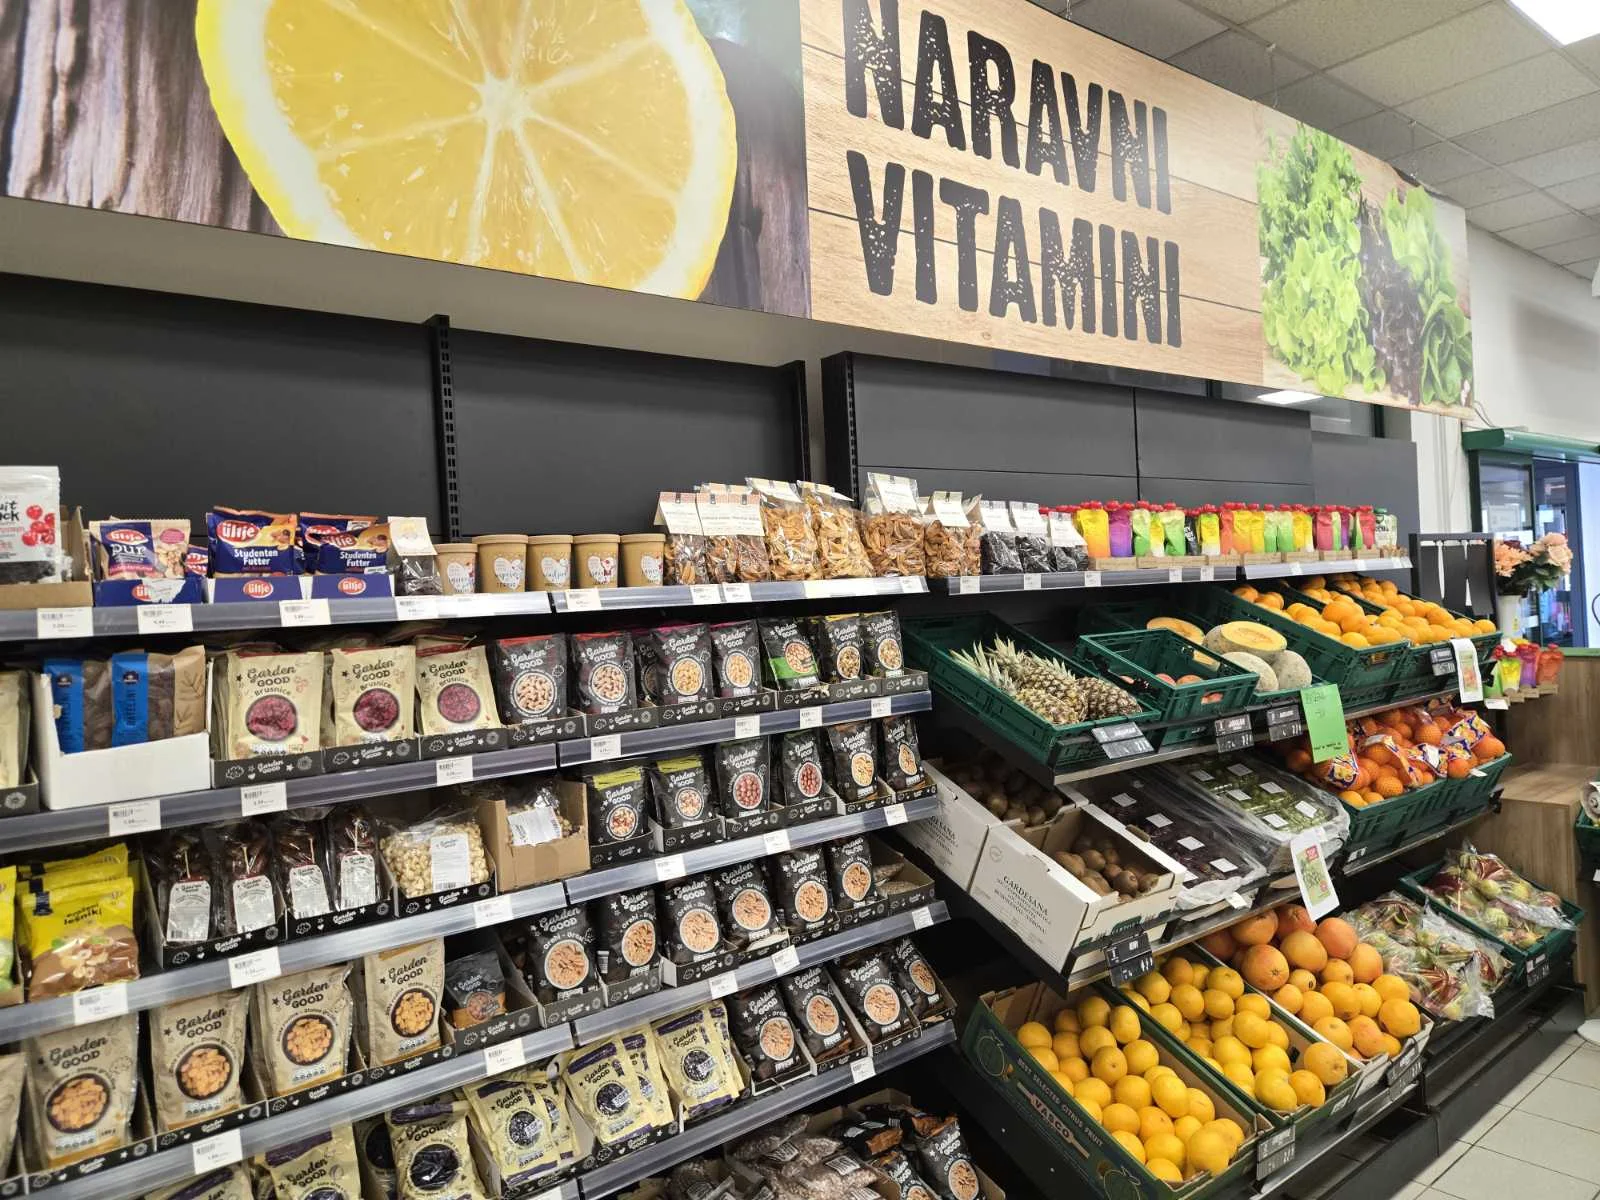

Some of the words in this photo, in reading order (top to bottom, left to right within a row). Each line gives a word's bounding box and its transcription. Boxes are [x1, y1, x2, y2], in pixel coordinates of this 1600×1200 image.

[842, 0, 1172, 215] NARAVNI
[846, 149, 1182, 348] VITAMINI
[221, 523, 255, 540] ültje
[110, 543, 146, 556] pur
[234, 549, 278, 558] Studenten
[340, 551, 376, 559] Studenten
[243, 558, 271, 566] Futter
[346, 559, 370, 567] Futter
[249, 583, 270, 594] ültje
[669, 634, 698, 651] Garden
[677, 643, 695, 653] GOOD
[510, 649, 546, 666] Garden
[586, 643, 618, 660] Garden
[595, 652, 616, 663] GOOD
[352, 658, 394, 679] Garden
[429, 659, 467, 676] Garden
[520, 658, 543, 669] GOOD
[247, 665, 296, 683] Garden
[257, 676, 290, 687] GOOD
[362, 670, 391, 682] GOOD
[439, 668, 465, 679] GOOD
[730, 749, 758, 764] Garden
[736, 758, 755, 768] GOOD
[670, 771, 695, 784] Garden
[678, 778, 695, 786] GOOD
[605, 786, 633, 800] Garden
[613, 794, 631, 804] GOOD
[790, 854, 820, 872] Garden
[798, 862, 818, 873] GOOD
[721, 863, 754, 884] Garden
[731, 871, 753, 885] GOOD
[674, 881, 707, 898] Garden
[683, 889, 705, 901] GOOD
[1003, 875, 1048, 916] GARDESANA
[539, 907, 581, 931] Garden
[550, 917, 577, 932] GOOD
[388, 956, 427, 982] Garden
[397, 968, 423, 985] GOOD
[850, 958, 879, 980] Garden
[860, 966, 880, 982] GOOD
[282, 981, 329, 1005] Garden
[292, 993, 324, 1008] GOOD
[749, 989, 776, 1012] Garden
[758, 999, 778, 1015] GOOD
[176, 1007, 227, 1035] Garden
[187, 1021, 222, 1038] GOOD
[673, 1028, 698, 1048] Garden
[679, 1036, 697, 1048] GOOD
[50, 1036, 108, 1065] Garden
[62, 1050, 100, 1069] GOOD
[584, 1061, 610, 1083] Garden
[592, 1069, 610, 1083] GOOD
[496, 1088, 523, 1108] Garden
[505, 1096, 523, 1110] GOOD
[1035, 1099, 1070, 1138] VASCO
[1061, 1104, 1083, 1128] CITRUS
[286, 1158, 328, 1186] Garden
[298, 1169, 327, 1187] GOOD
